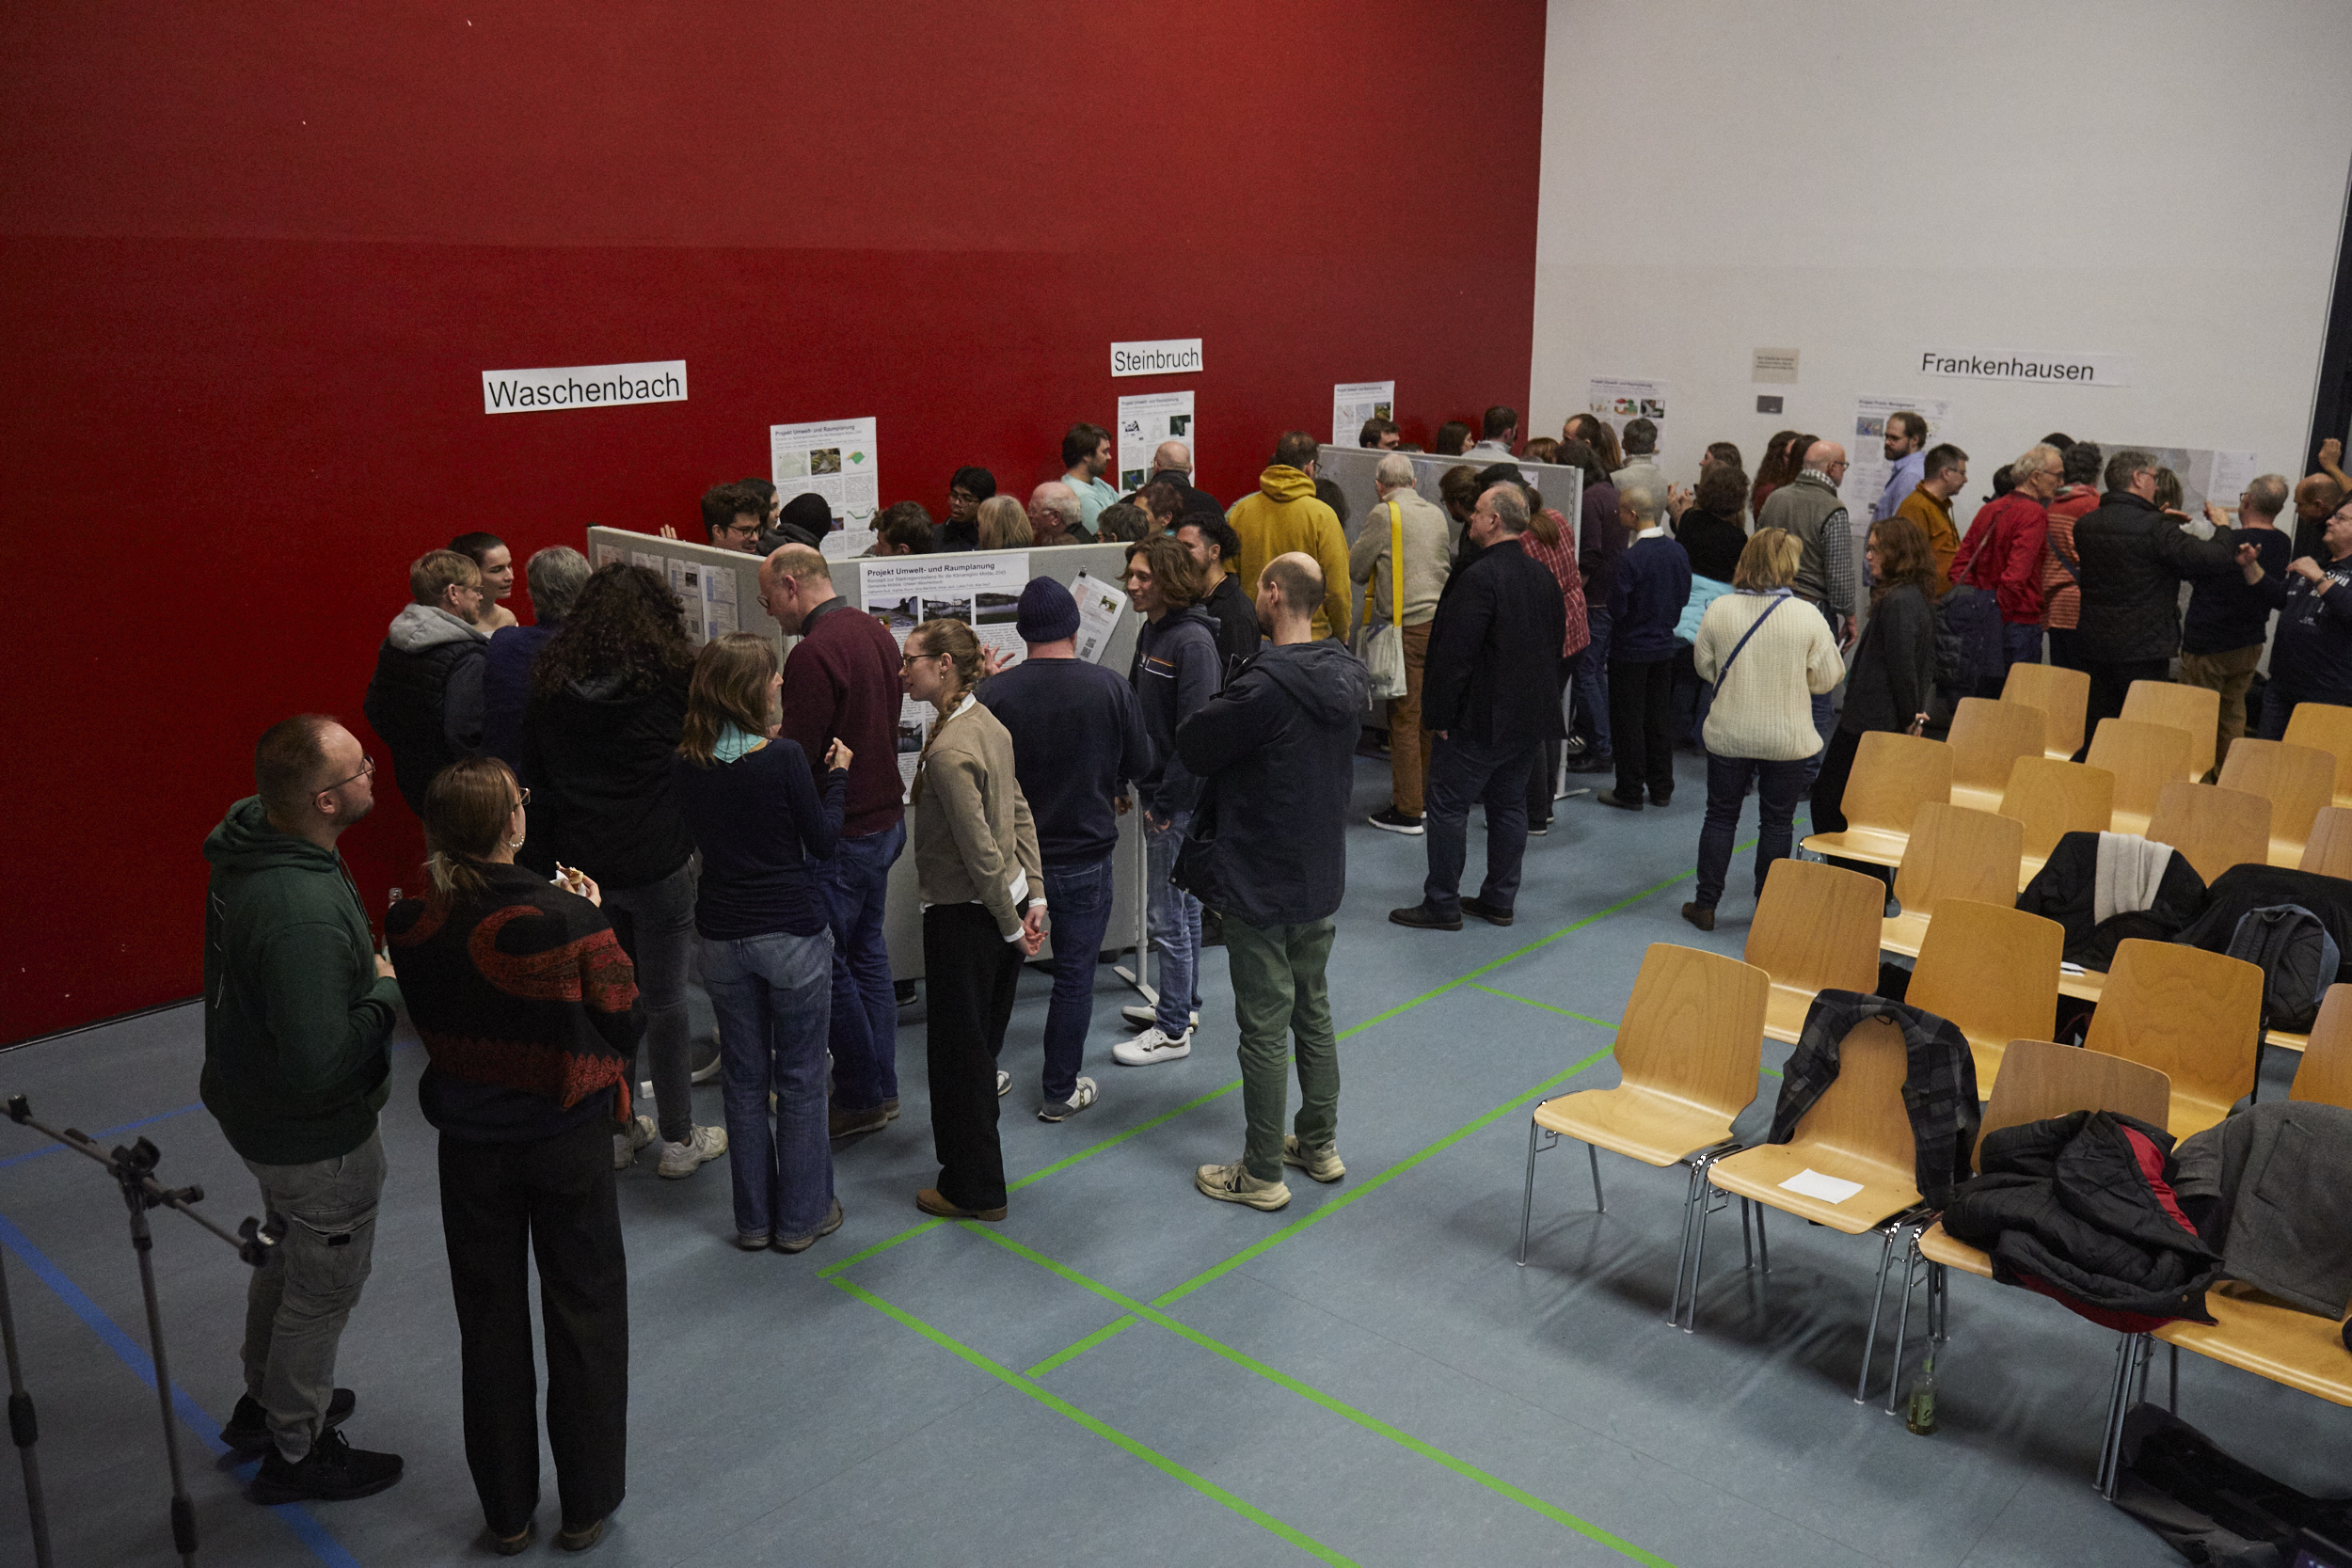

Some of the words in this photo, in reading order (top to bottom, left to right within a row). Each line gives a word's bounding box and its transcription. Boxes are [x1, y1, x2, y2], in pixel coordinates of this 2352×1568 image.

[1115, 347, 1199, 372] Steinbruch
[1921, 353, 2094, 381] Frankenhausen
[488, 372, 680, 407] Waschenbach
[867, 569, 894, 578] Projekt
[944, 562, 995, 572] Raumplanung
